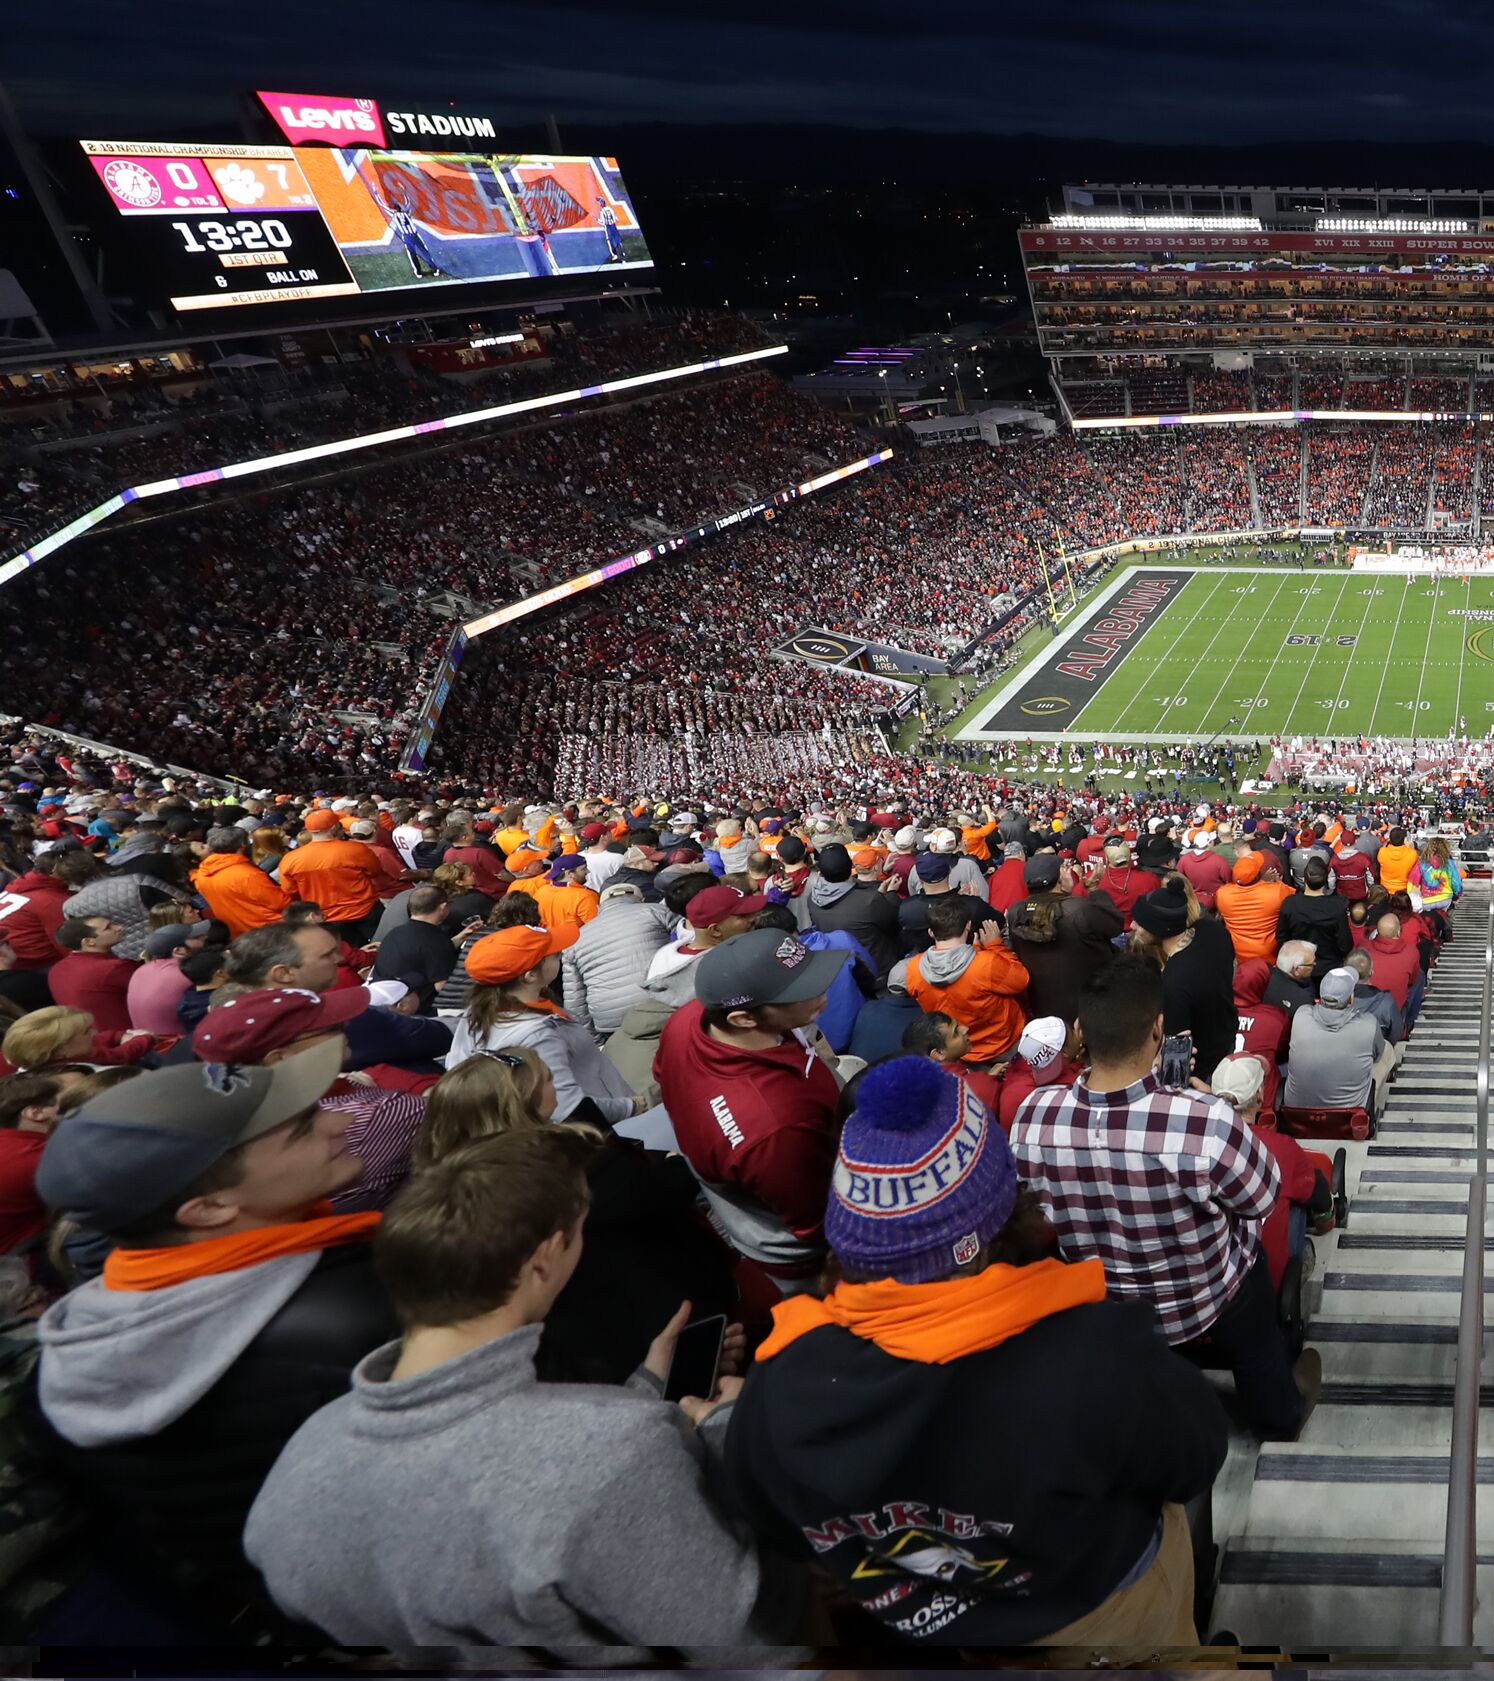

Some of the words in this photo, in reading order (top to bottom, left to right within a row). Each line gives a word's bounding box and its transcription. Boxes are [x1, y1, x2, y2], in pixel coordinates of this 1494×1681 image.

[387, 112, 496, 138] STADIUM
[115, 144, 173, 154] NATIONAL
[174, 145, 248, 155] CHAMPIONSHIP
[166, 162, 199, 190] 0
[265, 164, 289, 190] 7
[172, 219, 293, 252] 13:20
[1035, 237, 1046, 246] 8
[1056, 237, 1071, 246] 12
[1102, 237, 1116, 246] 16
[1123, 237, 1140, 246] 27
[1145, 237, 1162, 246] 33
[1167, 237, 1184, 246] 34
[1189, 237, 1206, 246] 35
[1211, 237, 1228, 246] 37
[1231, 237, 1248, 246] 39
[1253, 237, 1270, 246] 42
[1315, 239, 1334, 247] XVI
[1342, 239, 1360, 247] XIX
[1368, 240, 1394, 248] XXIII
[1406, 240, 1458, 249] SUPER
[229, 255, 250, 265] 1ST
[252, 254, 278, 266] QTR
[266, 270, 300, 284] BALL
[299, 269, 319, 281] ON
[1433, 274, 1467, 282] HOME
[1471, 274, 1489, 282] OF
[232, 289, 313, 304] #CFBPLAYOFF
[790, 489, 796, 499] 7
[740, 509, 751, 519] 1ST
[718, 513, 739, 529] 13:20
[1217, 532, 1283, 545] CHAMPIHIP
[1055, 578, 1179, 682] ALABAMA
[872, 654, 889, 663] BAY
[875, 663, 899, 671] AREA
[1159, 696, 1188, 707] 10
[1240, 697, 1269, 708] 20
[1321, 699, 1350, 710] 30
[1402, 700, 1431, 711] 40
[394, 835, 410, 850] 16
[1088, 854, 1104, 863] TITUS
[1237, 1016, 1255, 1031] RY
[710, 1095, 745, 1150] ALABAMA
[846, 1093, 987, 1209] BUFFALO
[958, 1244, 977, 1263] NFL
